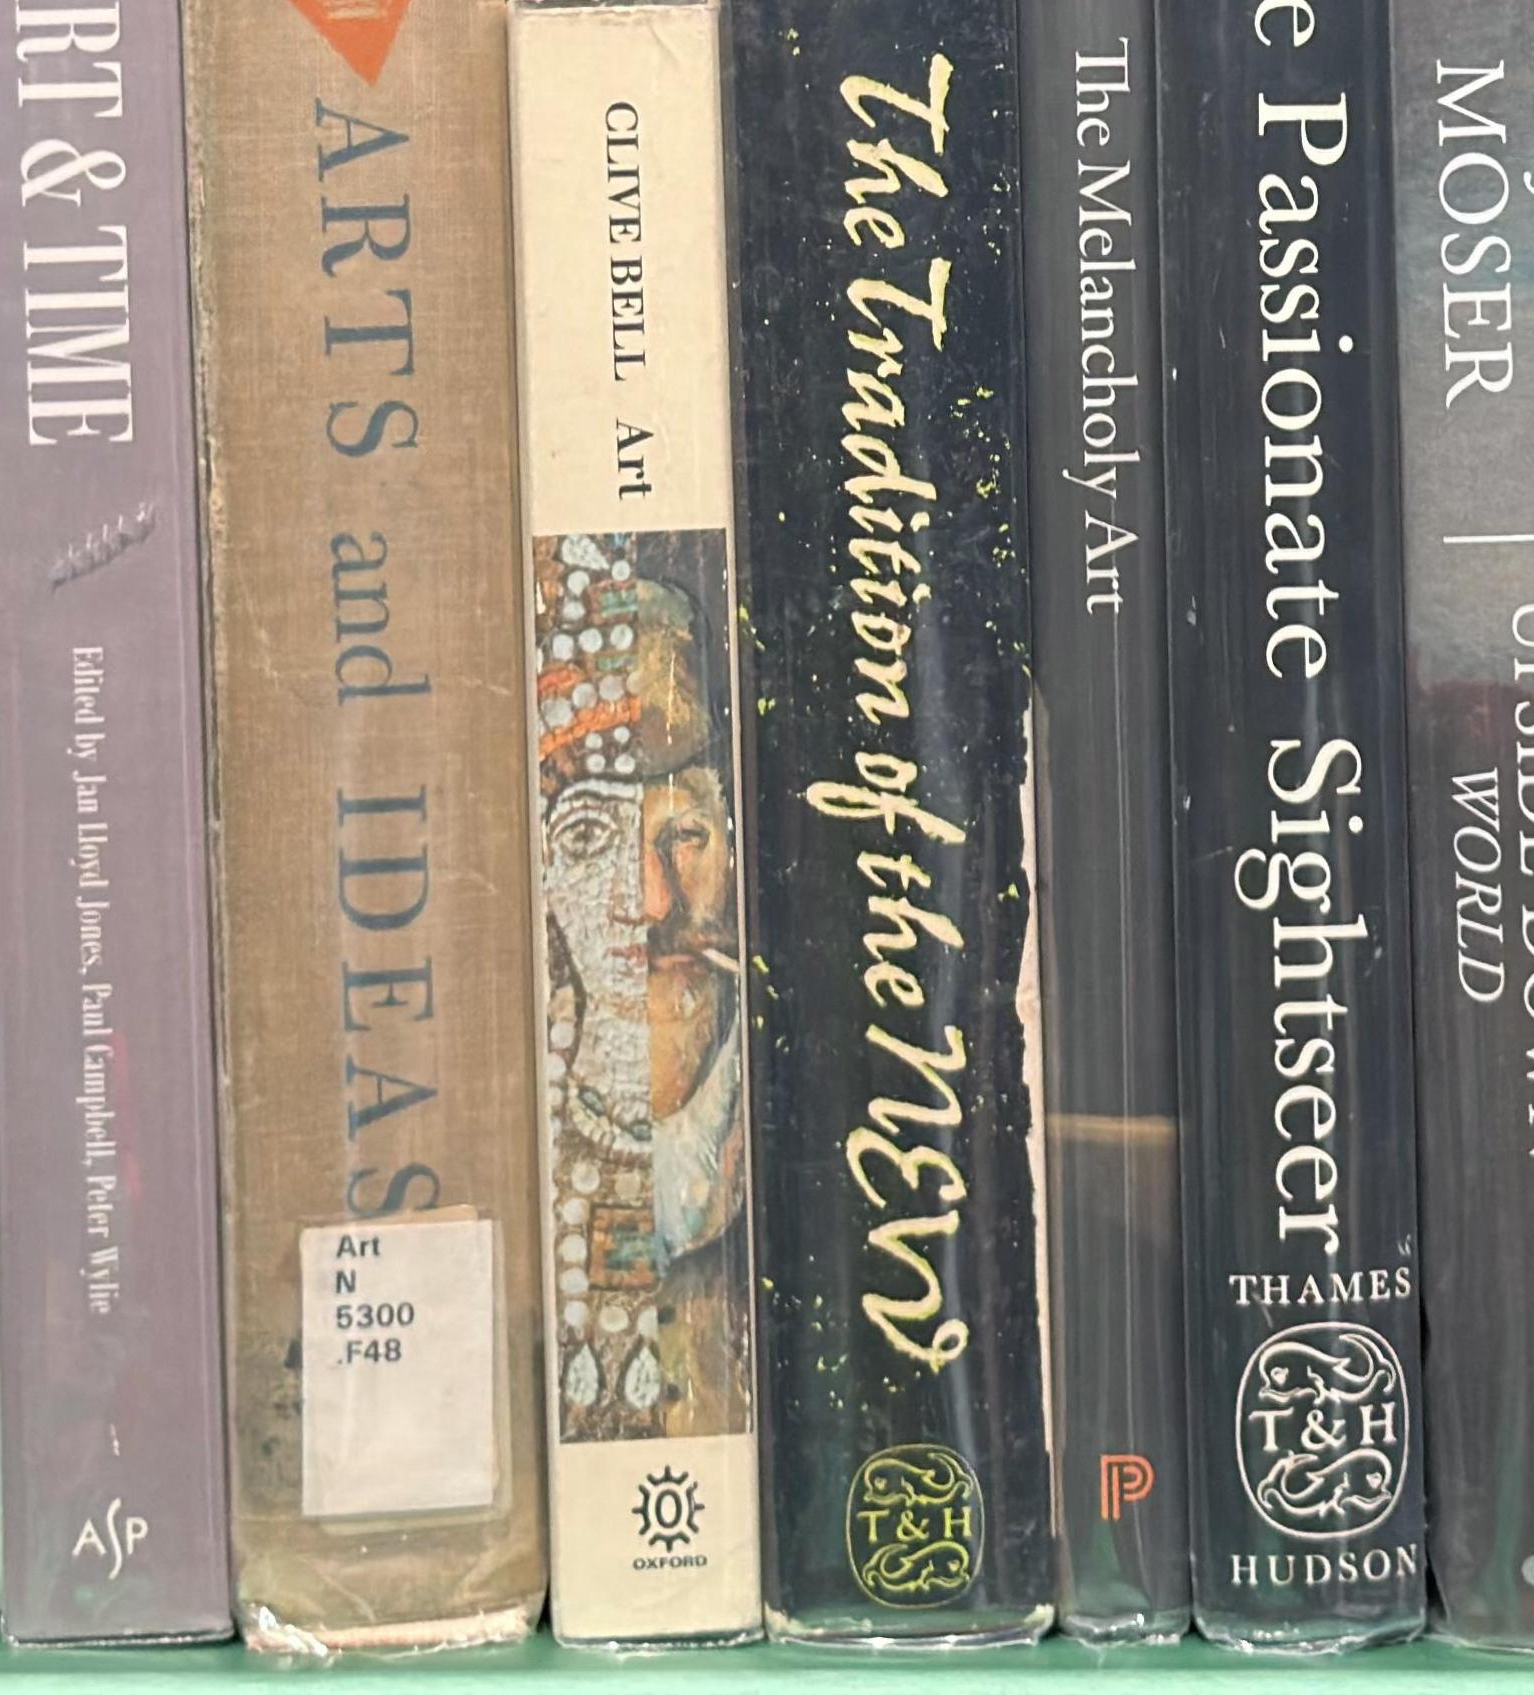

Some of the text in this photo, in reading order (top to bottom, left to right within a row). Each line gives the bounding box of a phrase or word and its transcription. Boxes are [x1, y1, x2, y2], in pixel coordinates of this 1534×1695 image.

[1061, 36, 1140, 614] The Melancholy Art
[1257, 91, 1356, 681] Passionate
[805, 52, 966, 1013] The Tradition of the
[315, 96, 442, 1220] ARTS and IDEAS
[66, 644, 120, 1315] Edited by Jan Lloyd Jones, Paul Campbell, Peter Wylie
[1234, 737, 1369, 1257] Sightseer
[334, 1235, 382, 1259] Art
[334, 1269, 356, 1293] N
[1230, 1269, 1413, 1308] THAMES
[334, 1302, 416, 1328] 5300
[334, 1338, 403, 1365] .F48
[632, 1553, 708, 1570] OXFORD
[1231, 1543, 1418, 1587] HUDSON
